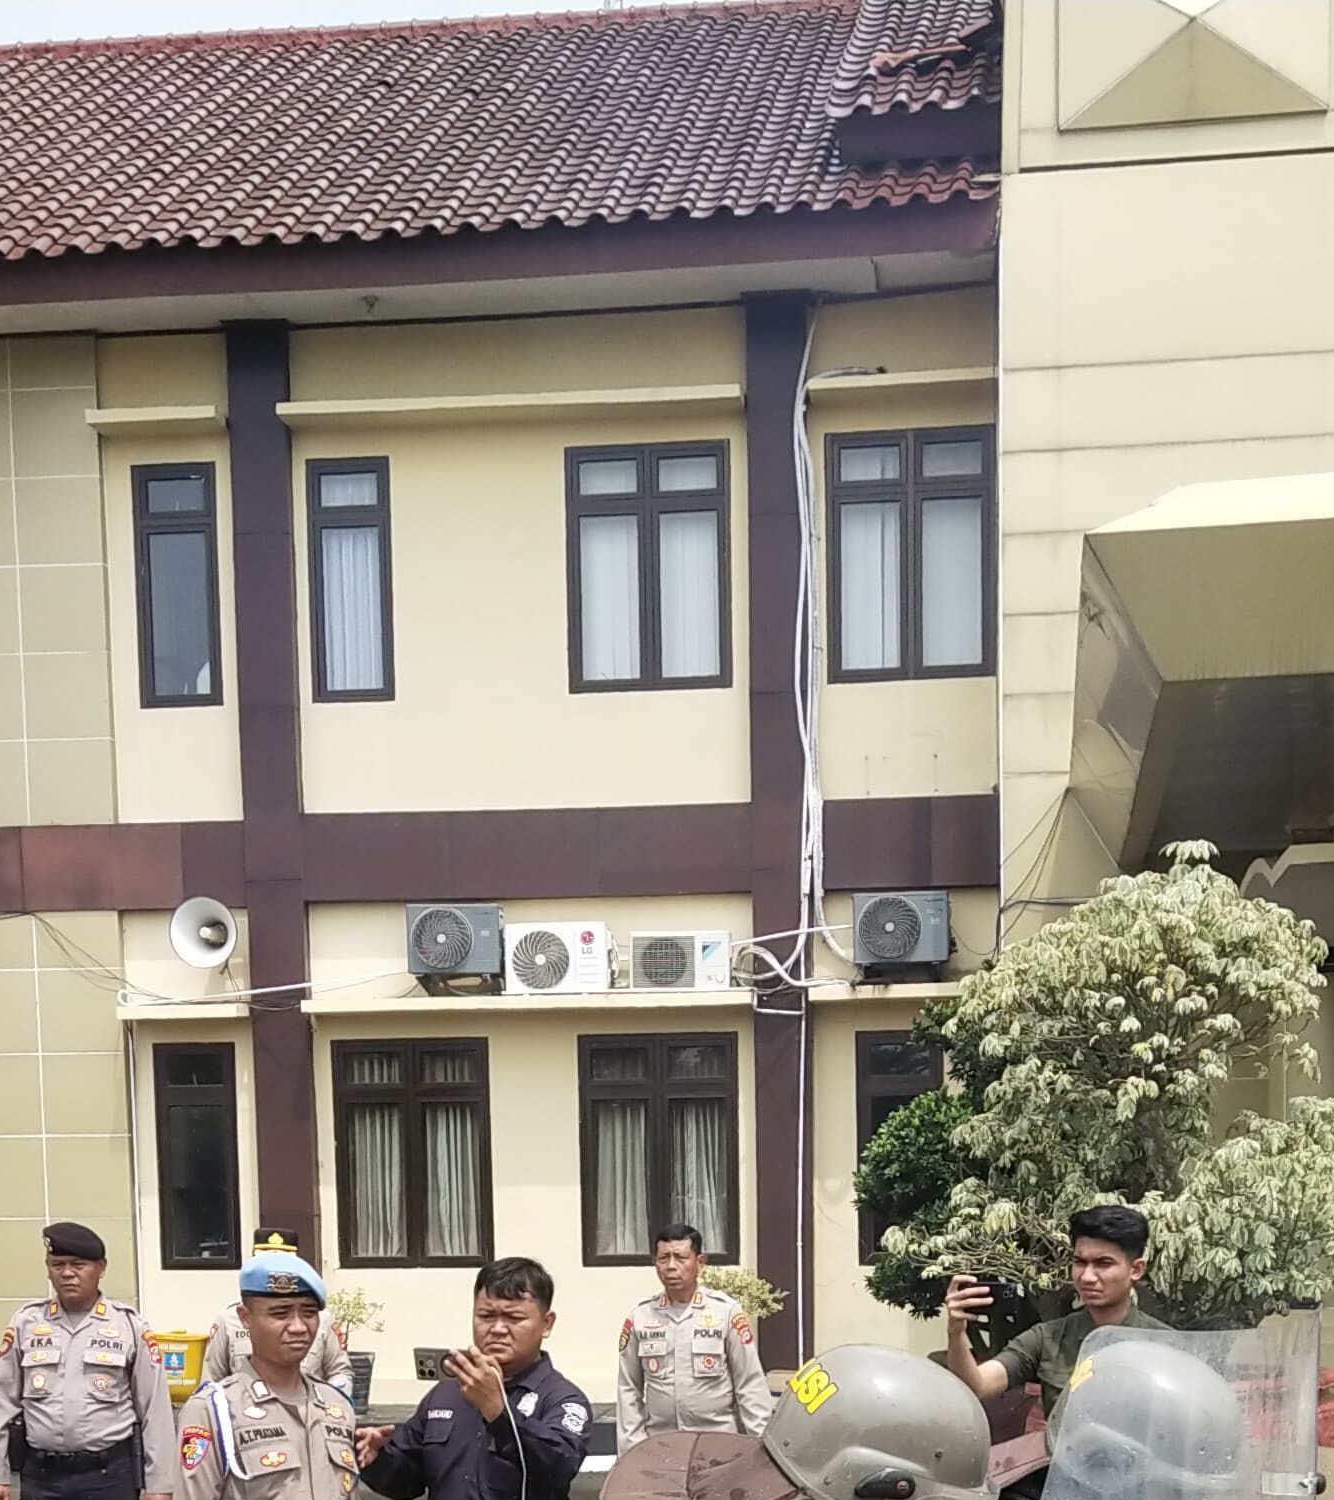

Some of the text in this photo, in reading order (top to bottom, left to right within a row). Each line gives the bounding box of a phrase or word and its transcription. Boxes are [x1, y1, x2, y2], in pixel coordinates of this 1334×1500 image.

[694, 1329, 723, 1338] POLRI
[30, 1337, 53, 1348] EKA
[90, 1338, 124, 1350] POLRI
